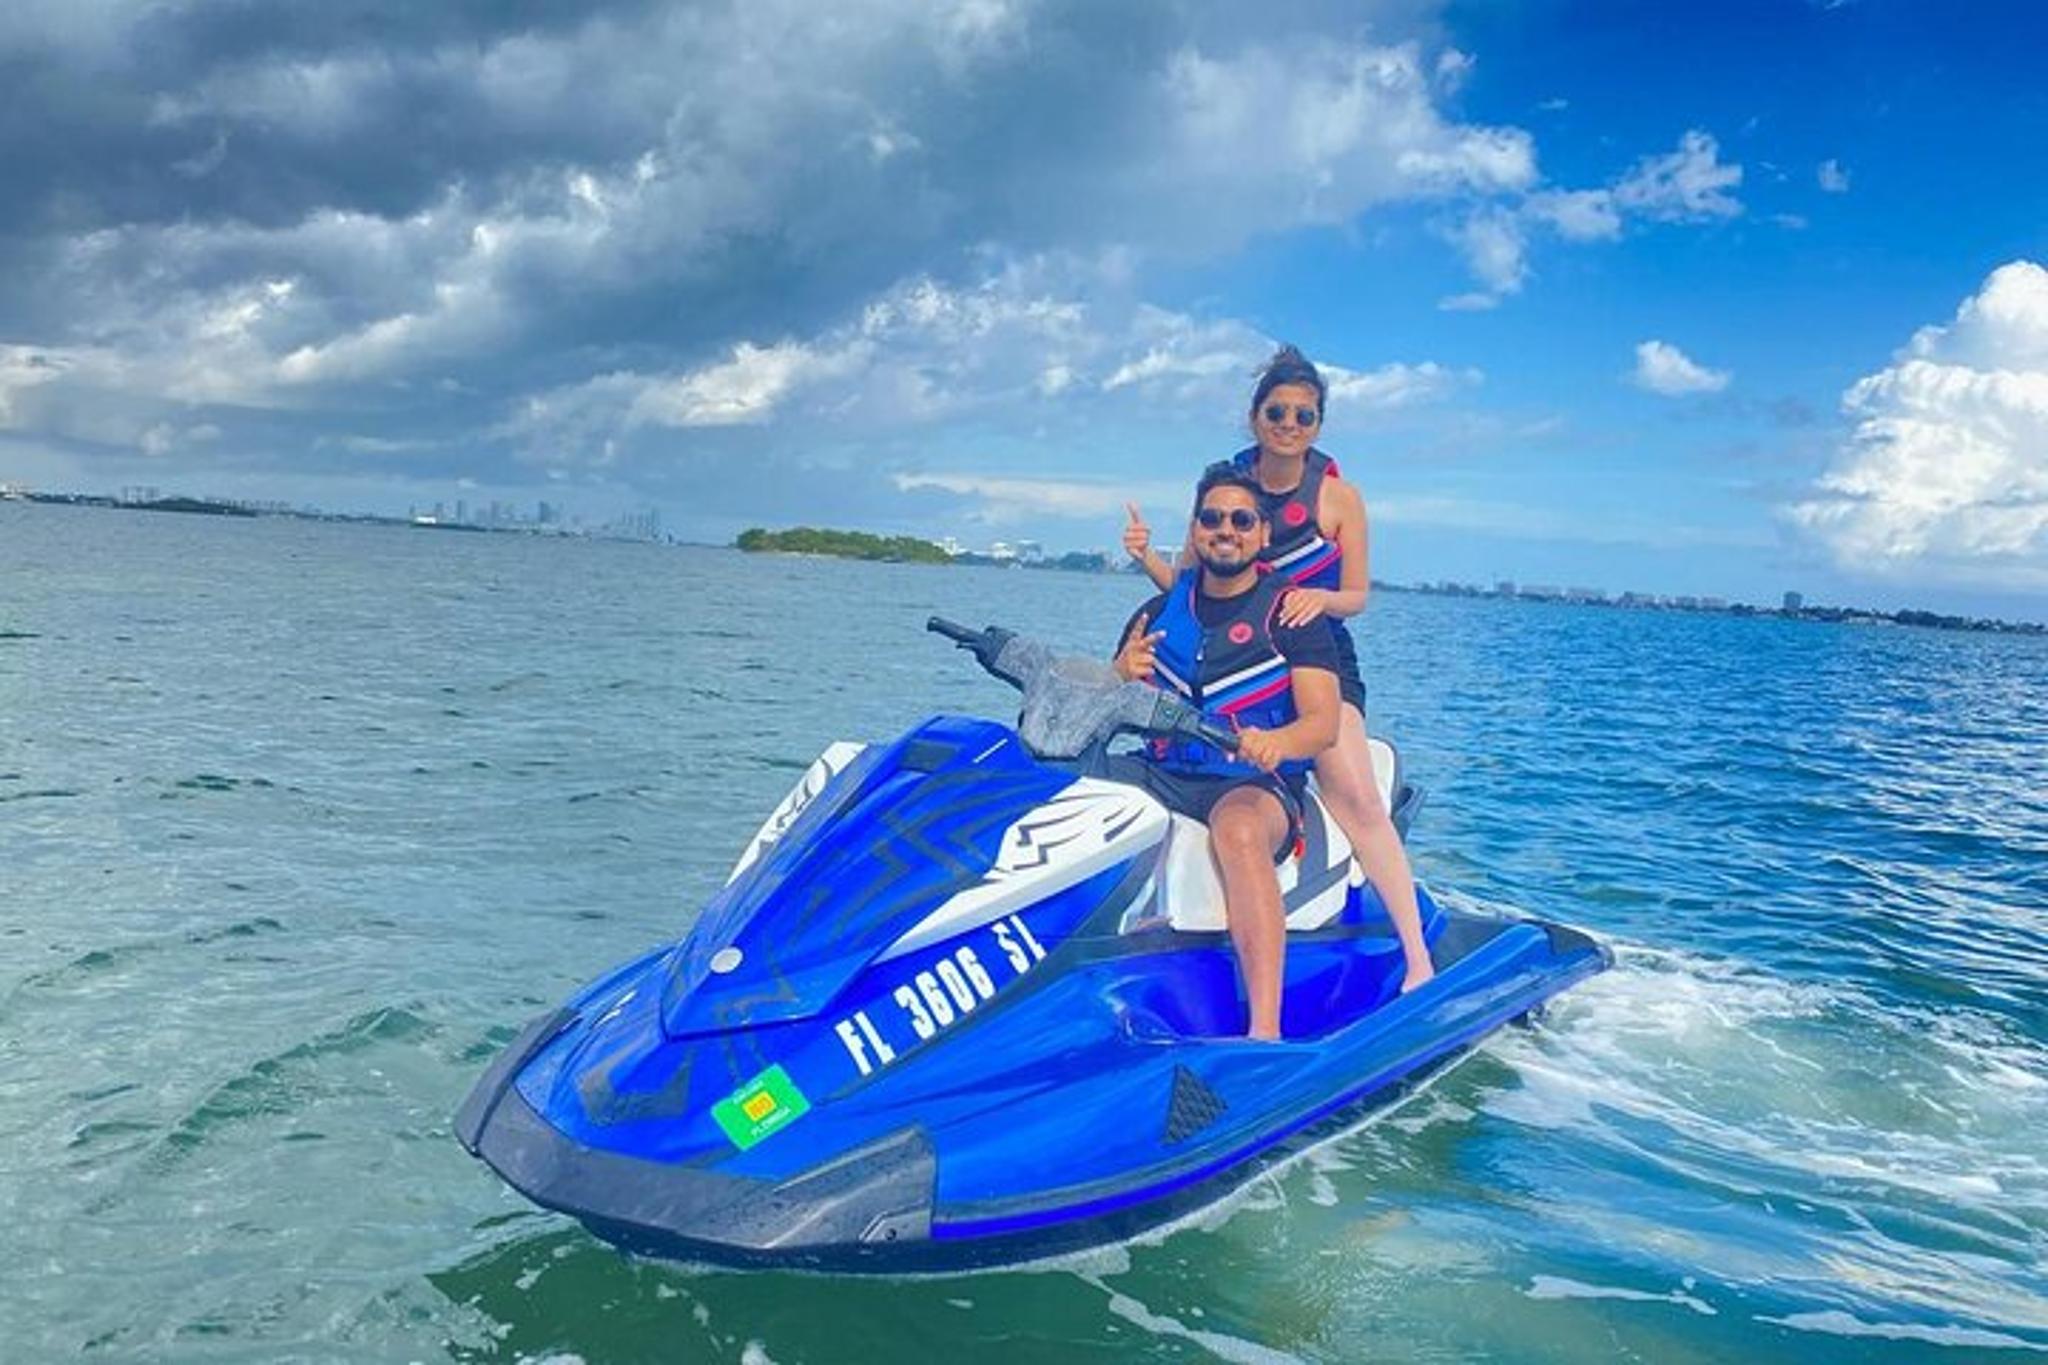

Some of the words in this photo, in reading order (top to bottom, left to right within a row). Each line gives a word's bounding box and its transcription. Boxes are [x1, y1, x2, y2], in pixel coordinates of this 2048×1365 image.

[835, 1011, 896, 1076] FL
[893, 946, 995, 1040] 3606
[991, 914, 1047, 974] SL
